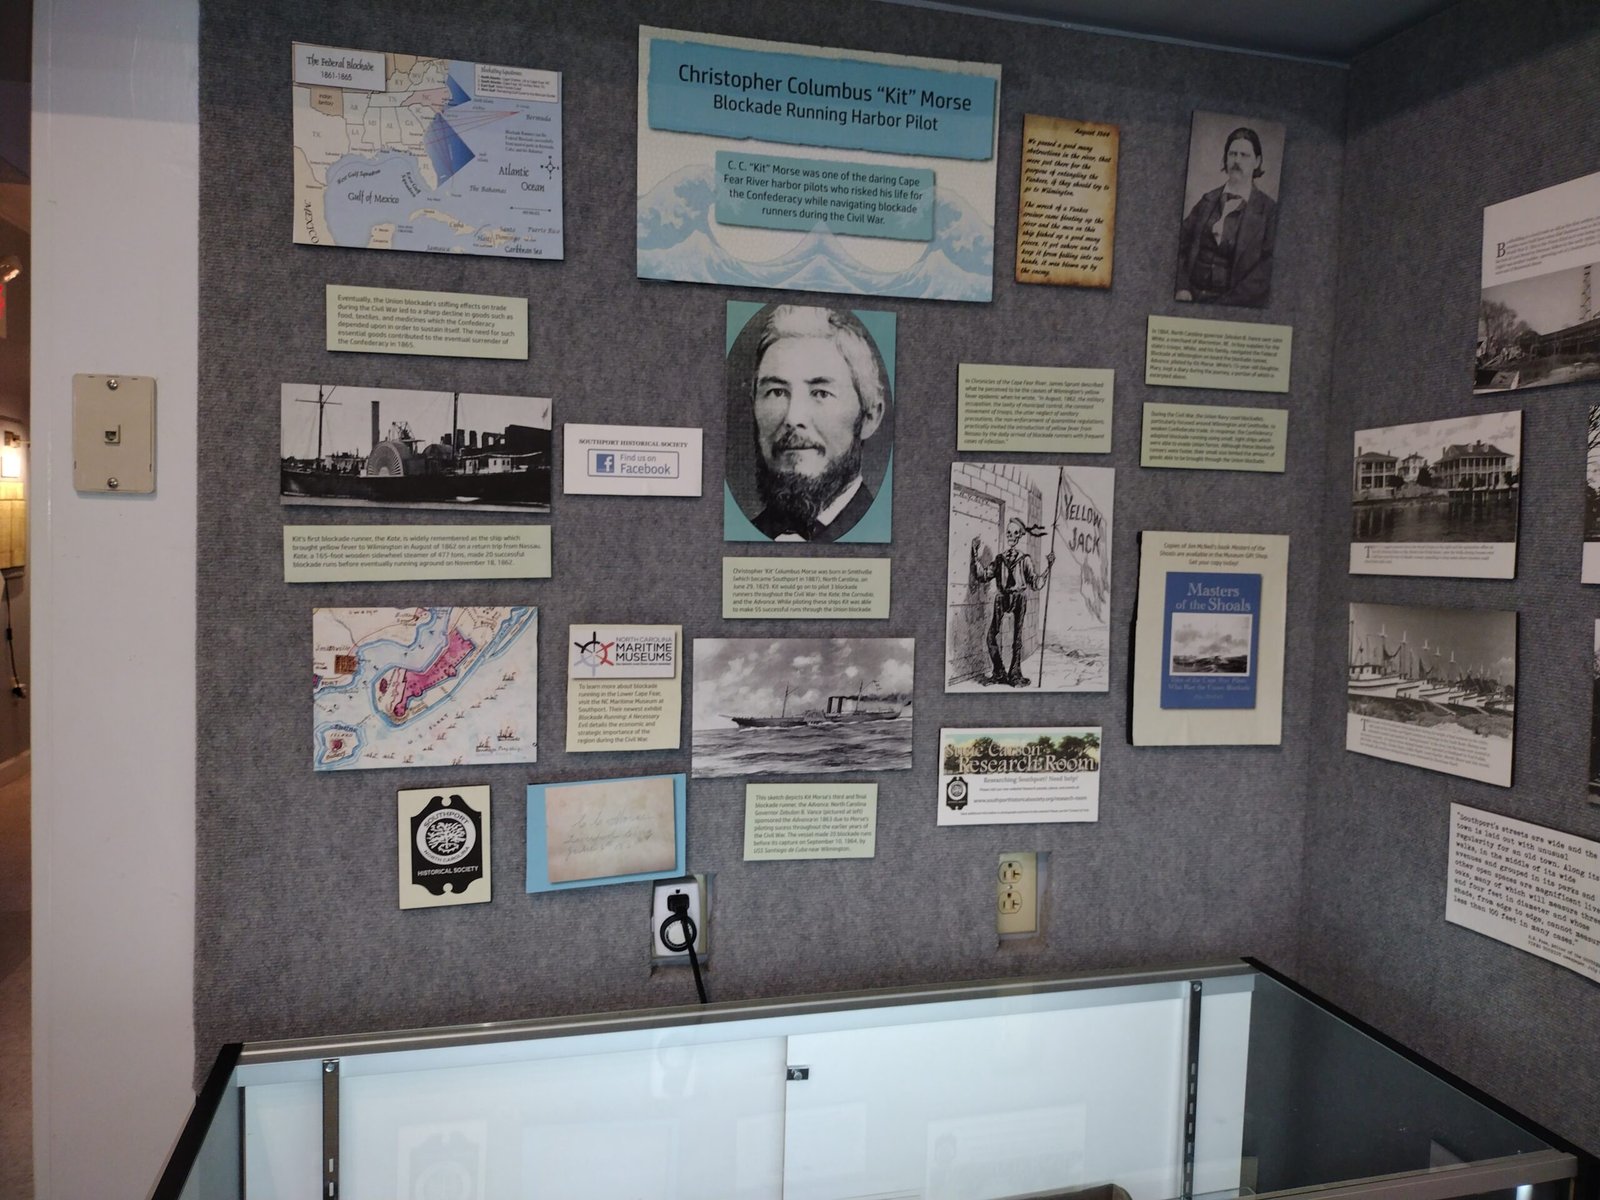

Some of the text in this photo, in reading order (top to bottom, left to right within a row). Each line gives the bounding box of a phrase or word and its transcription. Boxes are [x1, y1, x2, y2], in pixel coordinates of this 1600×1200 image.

[306, 53, 374, 72] The Federal Blockade
[321, 71, 352, 81] 1861-1865
[678, 64, 782, 93] Christopher
[787, 76, 872, 101] Columbus
[920, 90, 971, 111] Morse
[713, 94, 938, 131] Blockade Running Harbor Pilot
[499, 163, 529, 177] Atlantic
[727, 160, 736, 169] C.
[738, 161, 747, 171] C.
[772, 164, 800, 176] Morse
[802, 169, 820, 178] was
[821, 171, 838, 179] one
[840, 170, 849, 180] of
[851, 172, 866, 182] the
[868, 173, 896, 186] daring
[898, 175, 920, 187] Cape
[521, 181, 545, 192] Ocean
[723, 173, 922, 200] Fear River harbor pilots who risked his life for
[348, 190, 400, 204] Gulf of Mexico
[729, 188, 917, 213] the Confederacy while navigating blockade
[304, 199, 320, 244] MEXICO
[761, 207, 885, 224] runners during the Civil War.
[505, 245, 532, 255] Caribbean
[337, 294, 372, 303] Eventually,
[404, 298, 436, 306] blockade's
[437, 301, 459, 309] stifling
[349, 338, 389, 347] Confederacy
[620, 453, 636, 461] Find
[620, 462, 670, 474] Facebook
[1064, 494, 1101, 529] YELLOW
[1069, 527, 1100, 558] JACK
[1187, 583, 1240, 597] Masters
[1175, 597, 1251, 611] of the Shoals
[616, 643, 672, 652] MARITIME
[616, 652, 672, 662] MUSEUMS
[959, 755, 1094, 773] Research Room
[424, 811, 469, 827] SOUTHPORT
[1456, 822, 1472, 832] town
[1484, 829, 1500, 840] laid
[1502, 836, 1514, 845] out
[1517, 840, 1534, 850] with
[1537, 846, 1568, 861] unusual
[1501, 826, 1528, 838] streets
[1547, 839, 1564, 849] wide
[1567, 845, 1581, 854] and
[1584, 850, 1597, 859] the
[424, 846, 470, 862] NORTH CAROLINA
[1456, 832, 1494, 848] regularity
[1497, 843, 1509, 852] for
[1524, 852, 1536, 860] old
[1539, 856, 1560, 868] town.
[1562, 863, 1585, 878] Along
[1588, 871, 1600, 881] its
[1456, 841, 1477, 853] walks,
[1479, 847, 1487, 856] in
[1490, 851, 1502, 860] the
[1505, 856, 1529, 868] middle
[1544, 867, 1556, 877] its
[1558, 873, 1576, 884] wide
[417, 866, 479, 877] HISTORICAL SOCIETY
[1455, 850, 1595, 901] avenues and grouped in its parks and
[1454, 859, 1473, 869] other
[1476, 866, 1491, 876] open
[1494, 872, 1517, 884] spaces
[1519, 880, 1532, 889] are
[1535, 886, 1581, 907] magnificent
[1454, 868, 1471, 880] oaks,
[1474, 875, 1491, 889] many
[1505, 886, 1525, 897] which
[1528, 893, 1545, 904] will
[1548, 900, 1578, 916] measure
[1454, 878, 1590, 931] and four feet in diameter and whose
[1454, 887, 1474, 899] shade,
[1477, 894, 1493, 905] from
[1496, 902, 1512, 912] edge
[1525, 912, 1543, 925] edge,
[1546, 920, 1572, 935] cannot
[1454, 895, 1467, 905] less
[1470, 901, 1485, 912] than
[1501, 911, 1516, 924] feet
[1519, 919, 1528, 928] in
[1530, 924, 1549, 936] many
